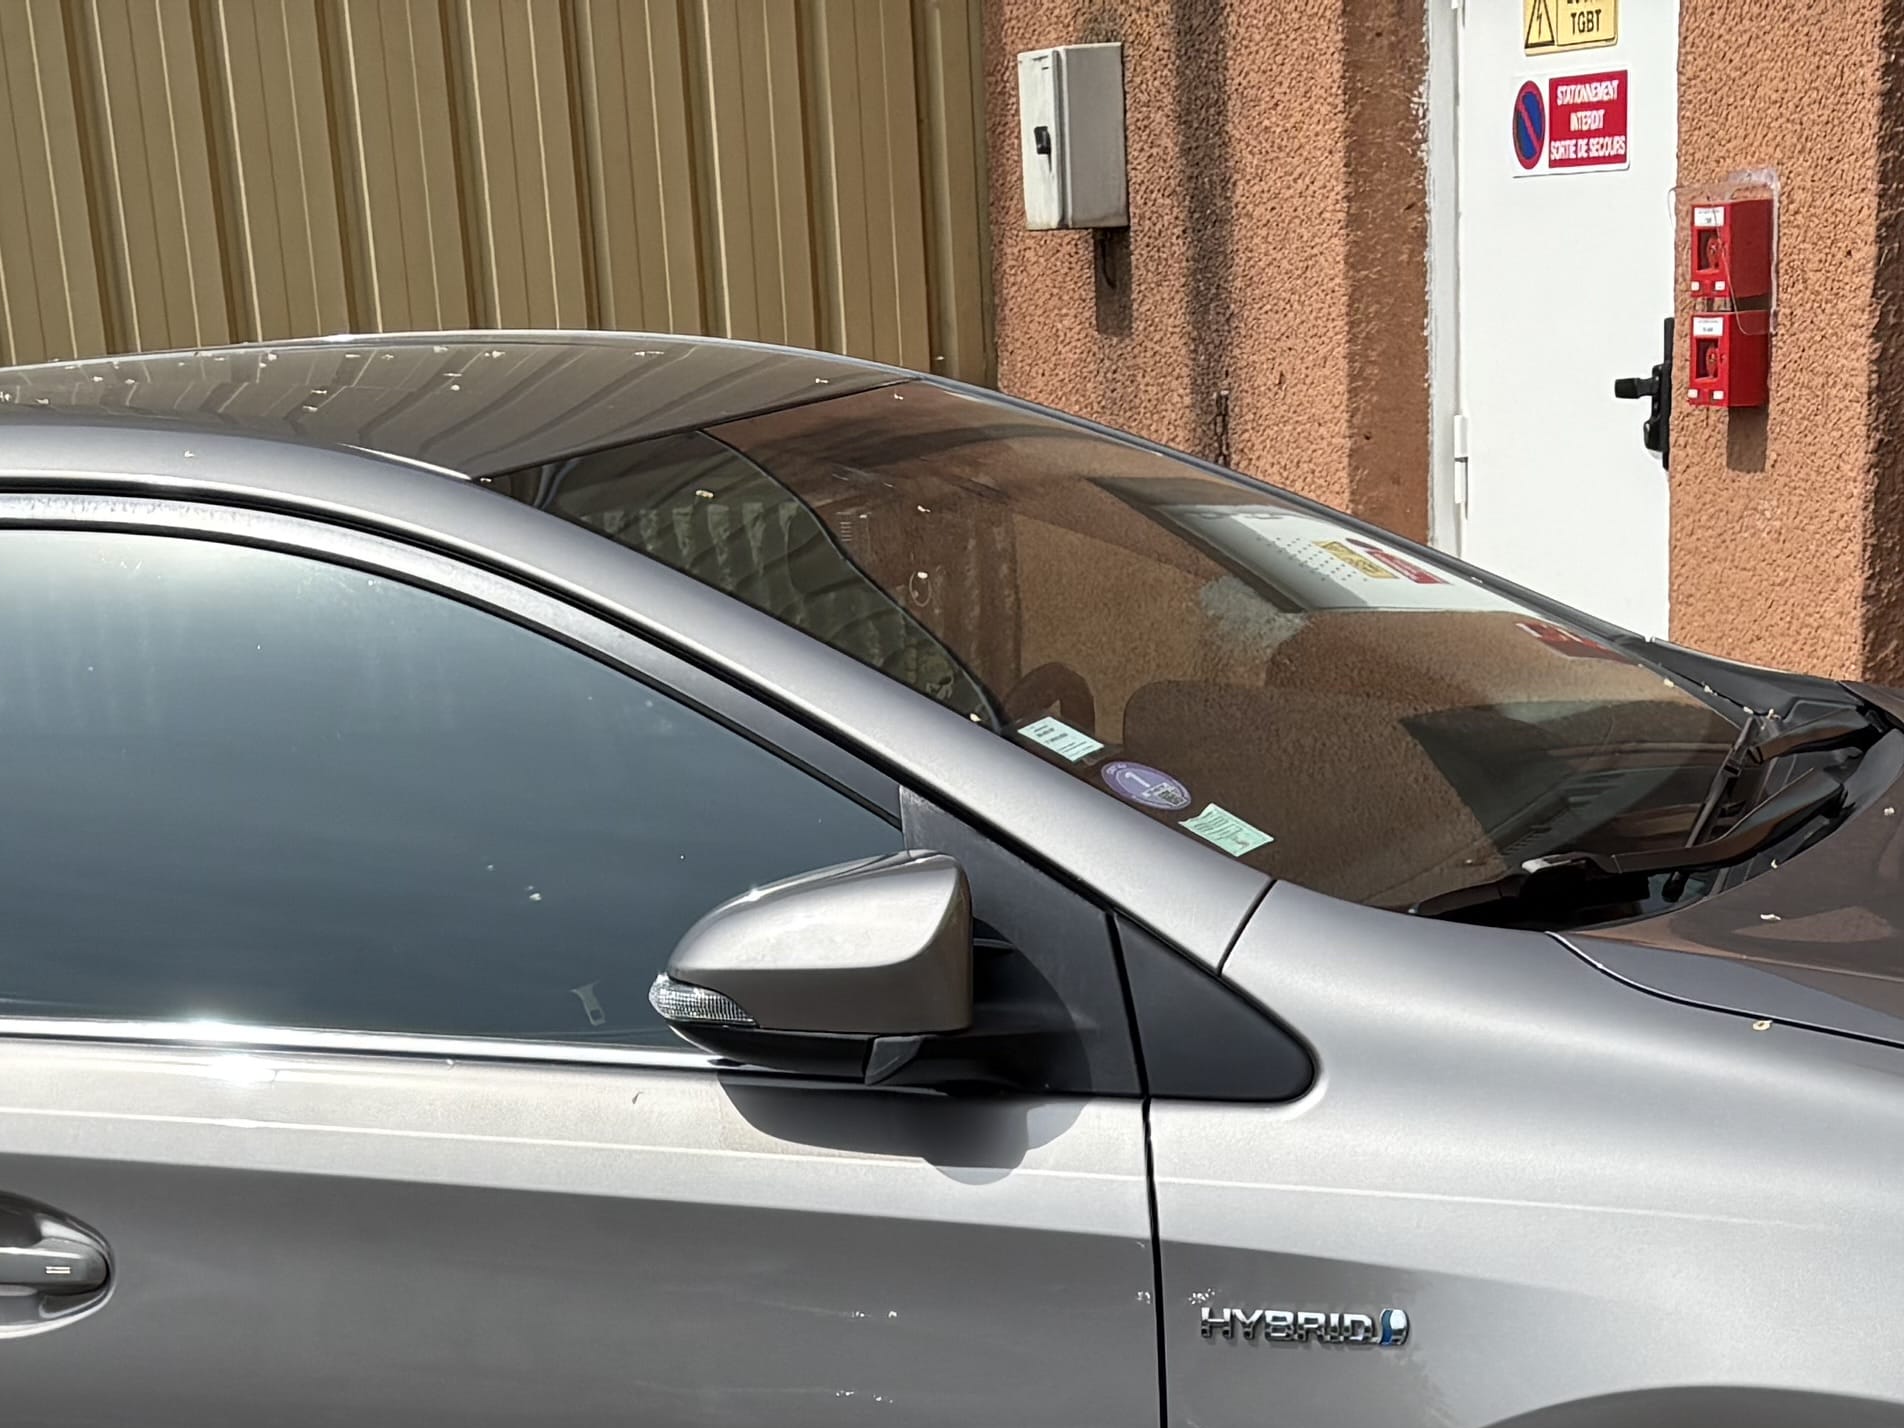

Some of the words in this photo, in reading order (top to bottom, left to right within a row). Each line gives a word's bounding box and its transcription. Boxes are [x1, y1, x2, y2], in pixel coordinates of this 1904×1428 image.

[1570, 9, 1602, 35] TGBT
[1557, 80, 1619, 106] STATIONNEMENT
[1570, 109, 1605, 131] INTERDIT
[1550, 139, 1576, 160] SORTIE
[1577, 138, 1588, 158] DE
[1589, 136, 1626, 157] SECOURS
[1200, 1306, 1375, 1345] HYBRID
